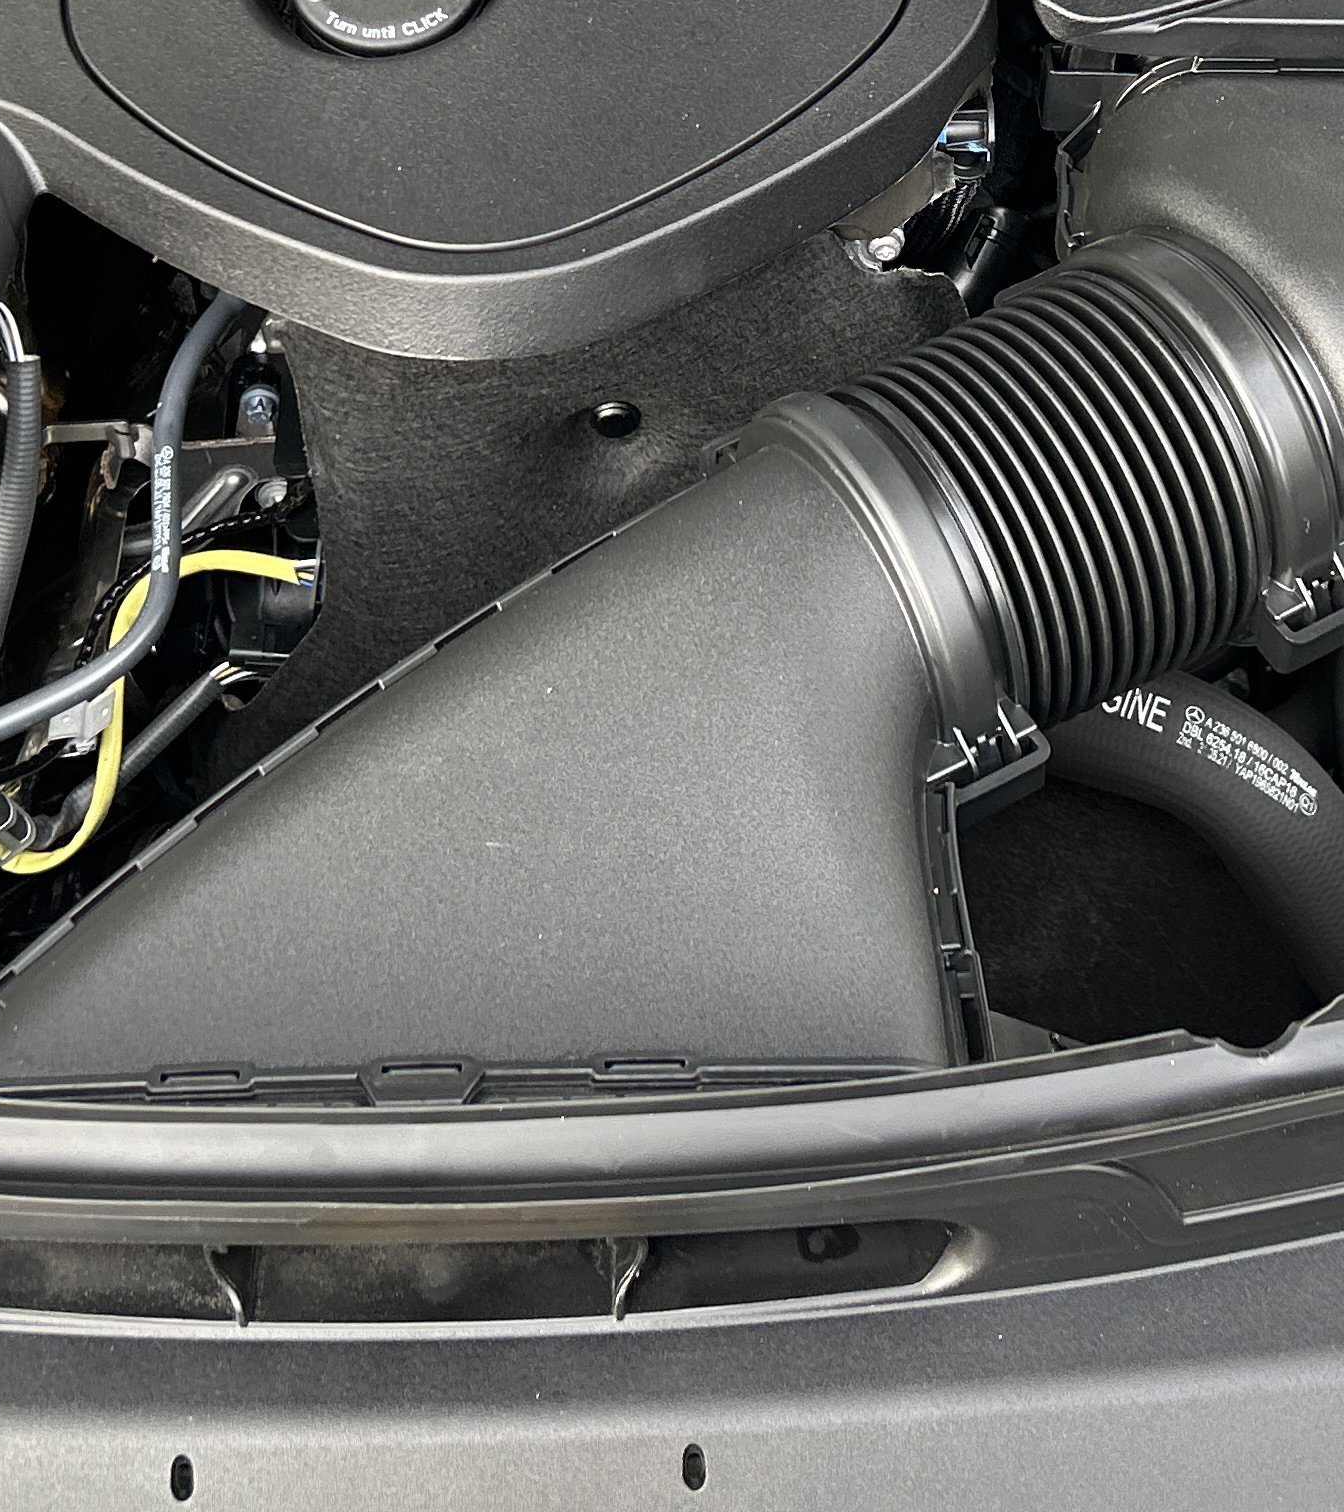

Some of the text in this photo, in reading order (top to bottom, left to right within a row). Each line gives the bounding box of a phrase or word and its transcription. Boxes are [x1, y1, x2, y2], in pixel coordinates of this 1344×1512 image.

[326, 7, 449, 39] Turn until CLICK
[1182, 720, 1204, 742] DBL
[1204, 717, 1213, 729] A
